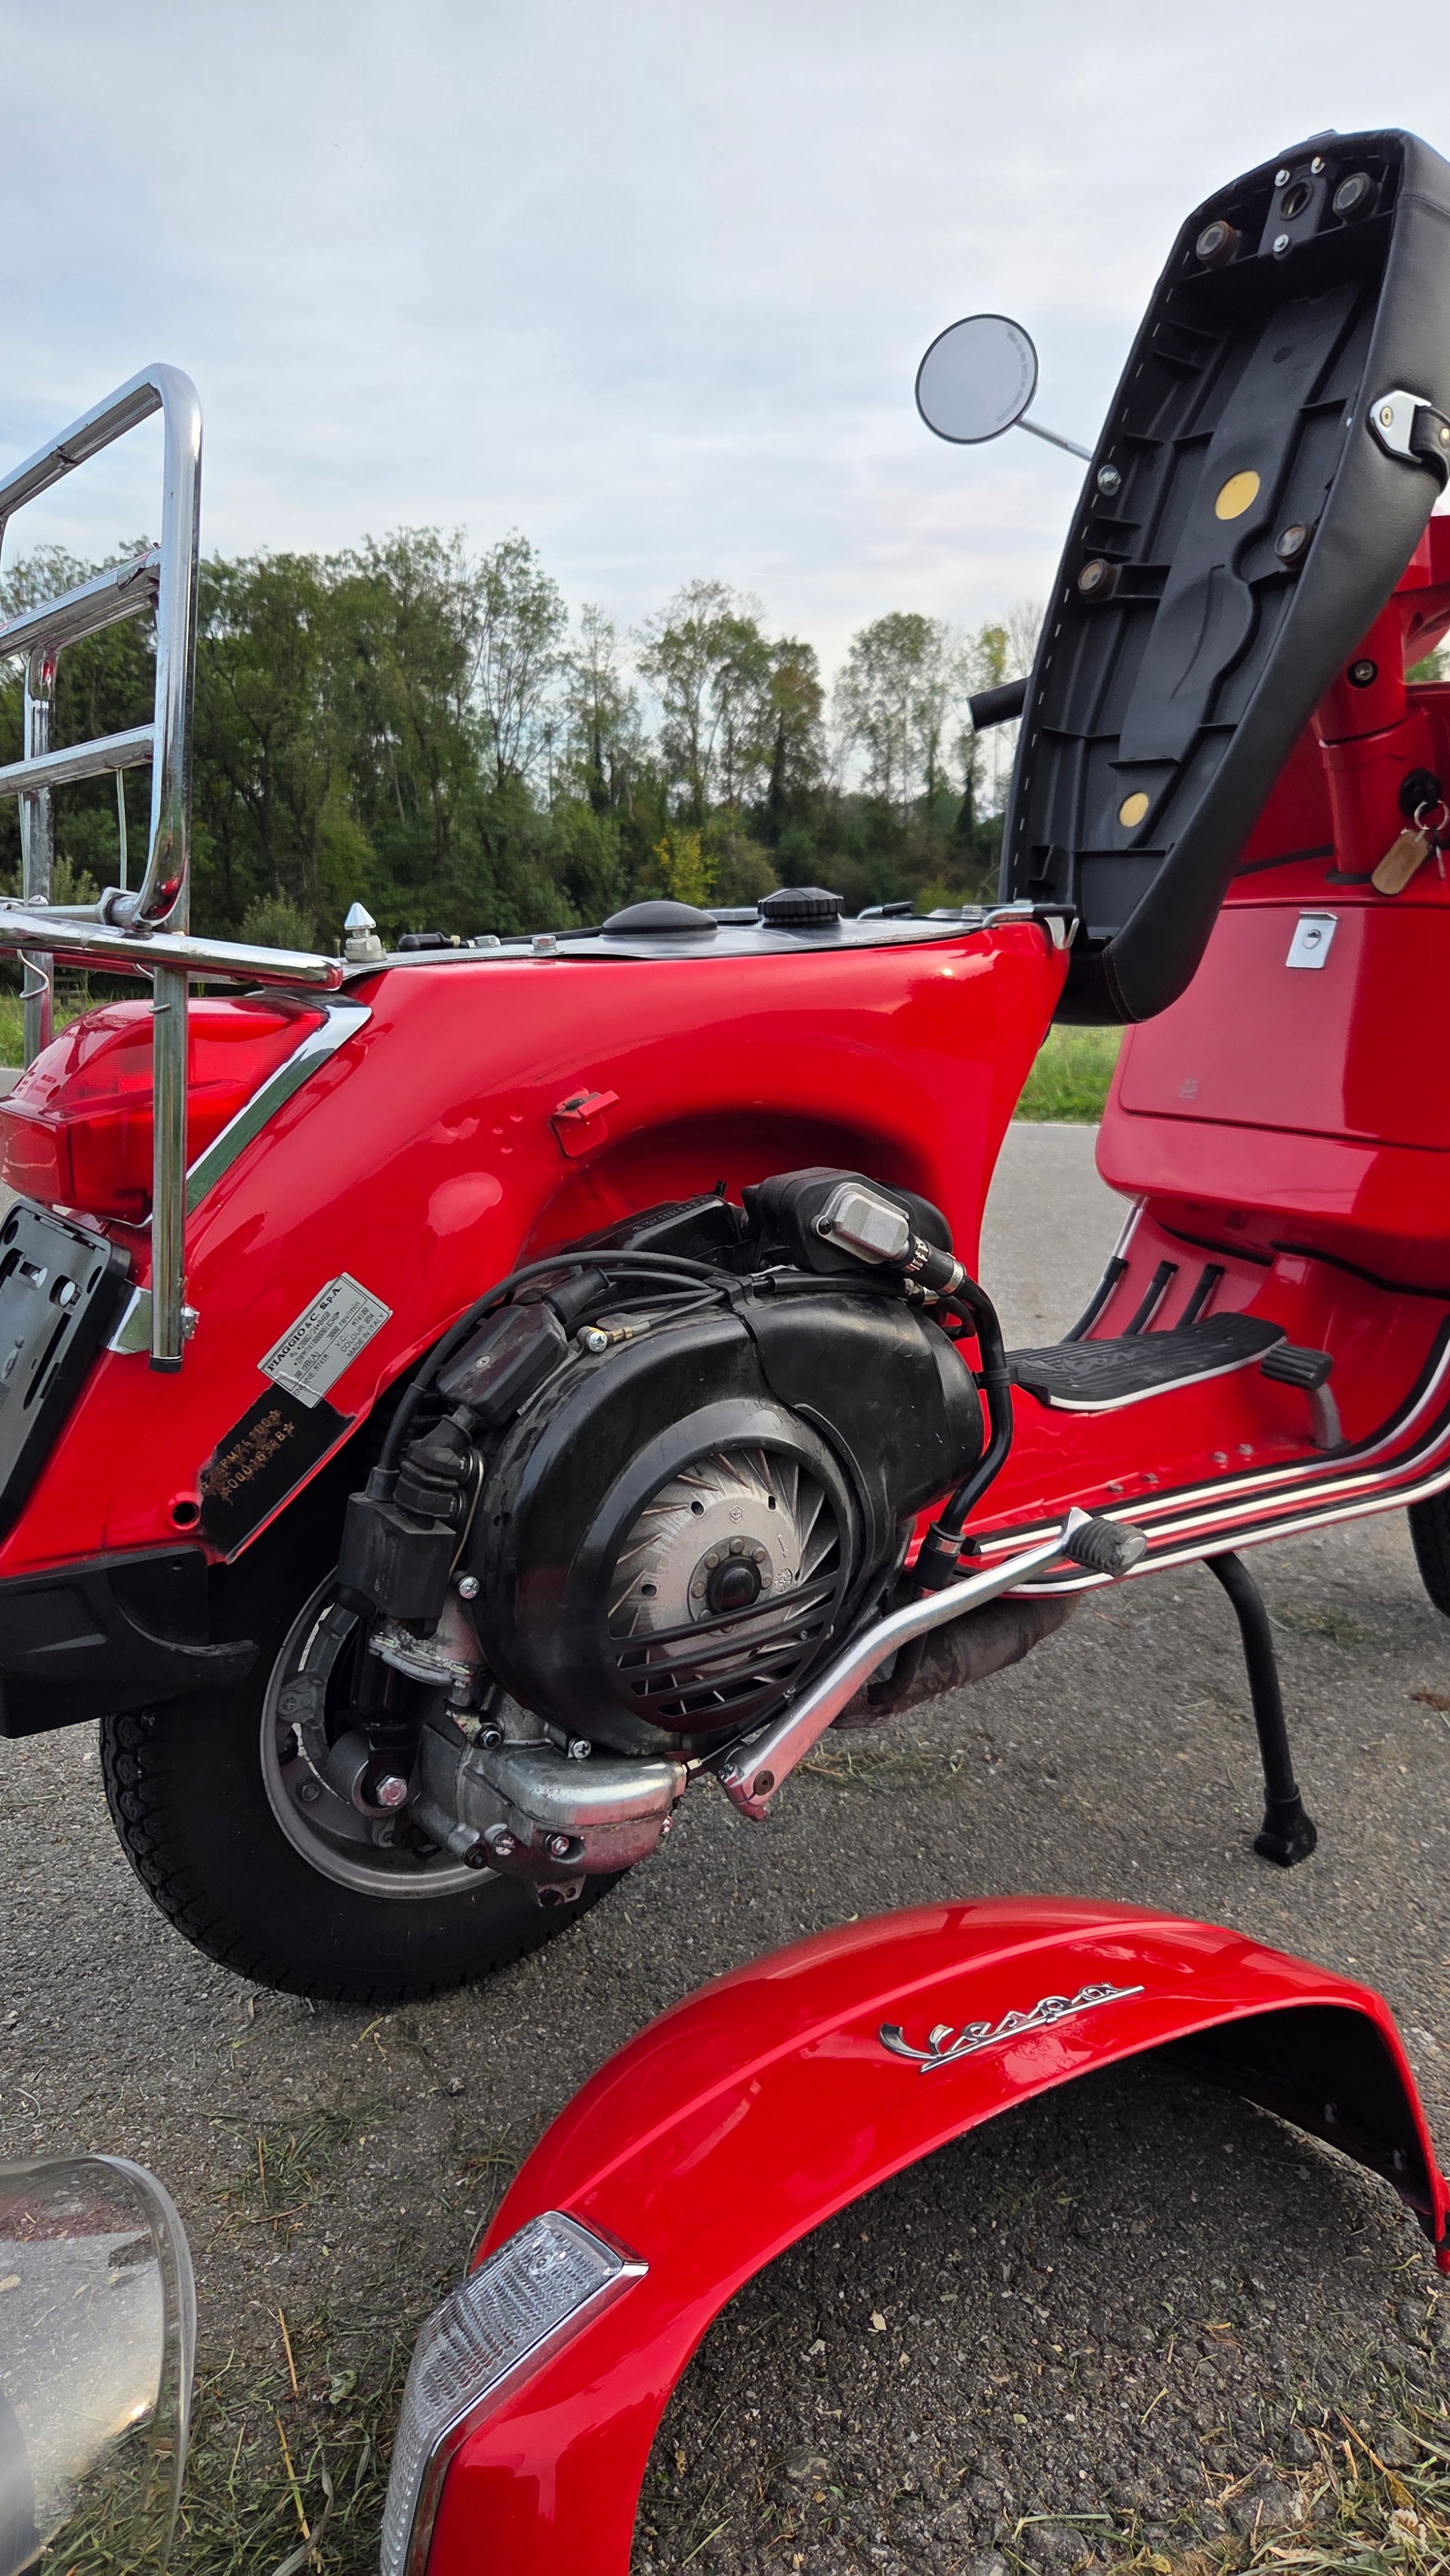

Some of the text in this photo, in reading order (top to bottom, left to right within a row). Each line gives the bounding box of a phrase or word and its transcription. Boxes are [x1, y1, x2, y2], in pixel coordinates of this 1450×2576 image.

[267, 1327, 306, 1372] PIAGGIO
[304, 1320, 312, 1329] &
[319, 1286, 343, 1311] S.p.A.
[300, 1349, 321, 1371] dB(A)
[338, 1300, 361, 1327] rev/min
[339, 1323, 366, 1353] COLOUR:
[346, 1312, 385, 1357] MADE IN ITALY
[878, 1981, 1145, 2073] Vespa
